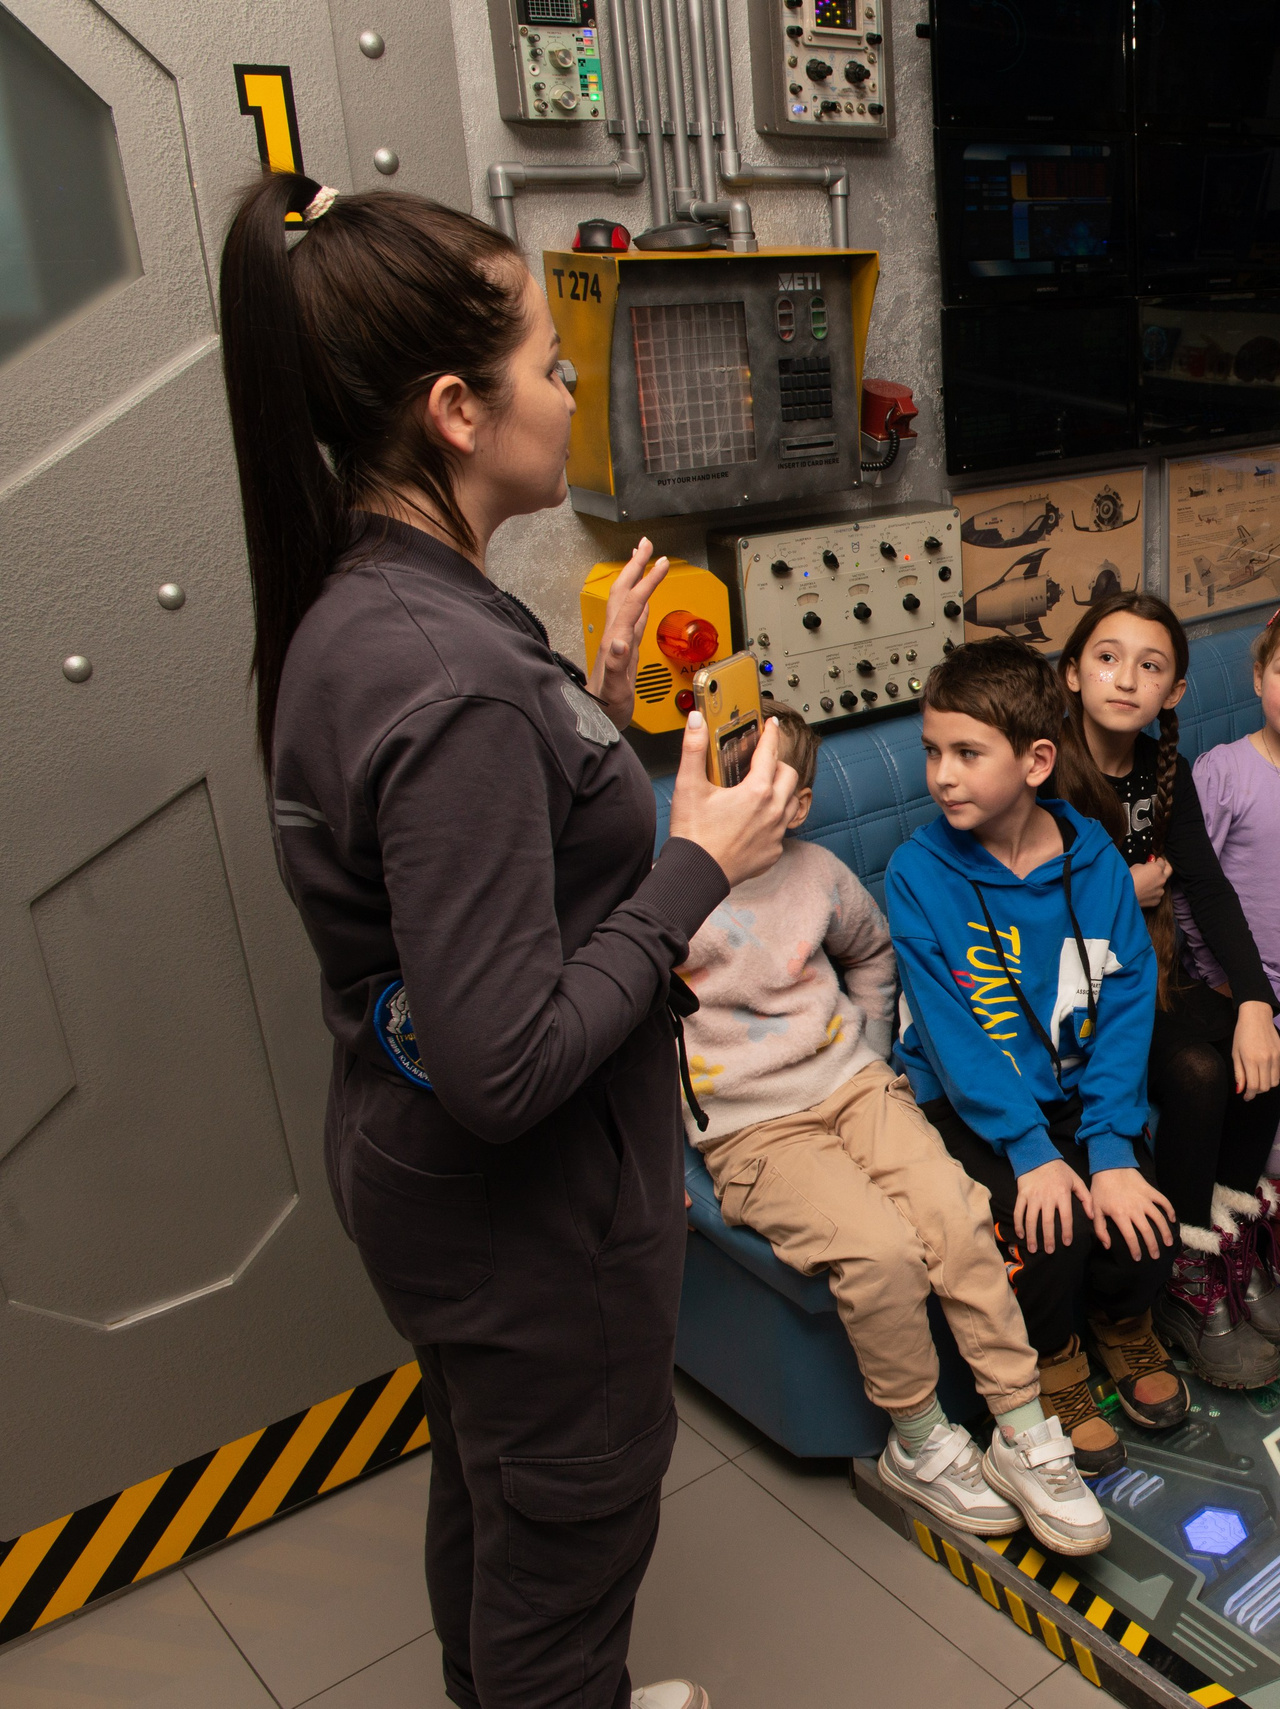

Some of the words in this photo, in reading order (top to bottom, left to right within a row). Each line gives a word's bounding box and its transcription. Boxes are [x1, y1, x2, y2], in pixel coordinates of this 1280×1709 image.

[234, 64, 307, 231] 1
[553, 269, 564, 298] T
[569, 270, 602, 303] 274
[778, 273, 821, 291] METI
[778, 462, 800, 470] INSERT
[807, 459, 824, 468] CARD
[824, 457, 840, 466] HERE
[657, 479, 671, 487] PUT
[671, 476, 691, 486] YOUR
[692, 473, 711, 484] HAND
[711, 471, 729, 481] HERE
[680, 660, 721, 675] ALA
